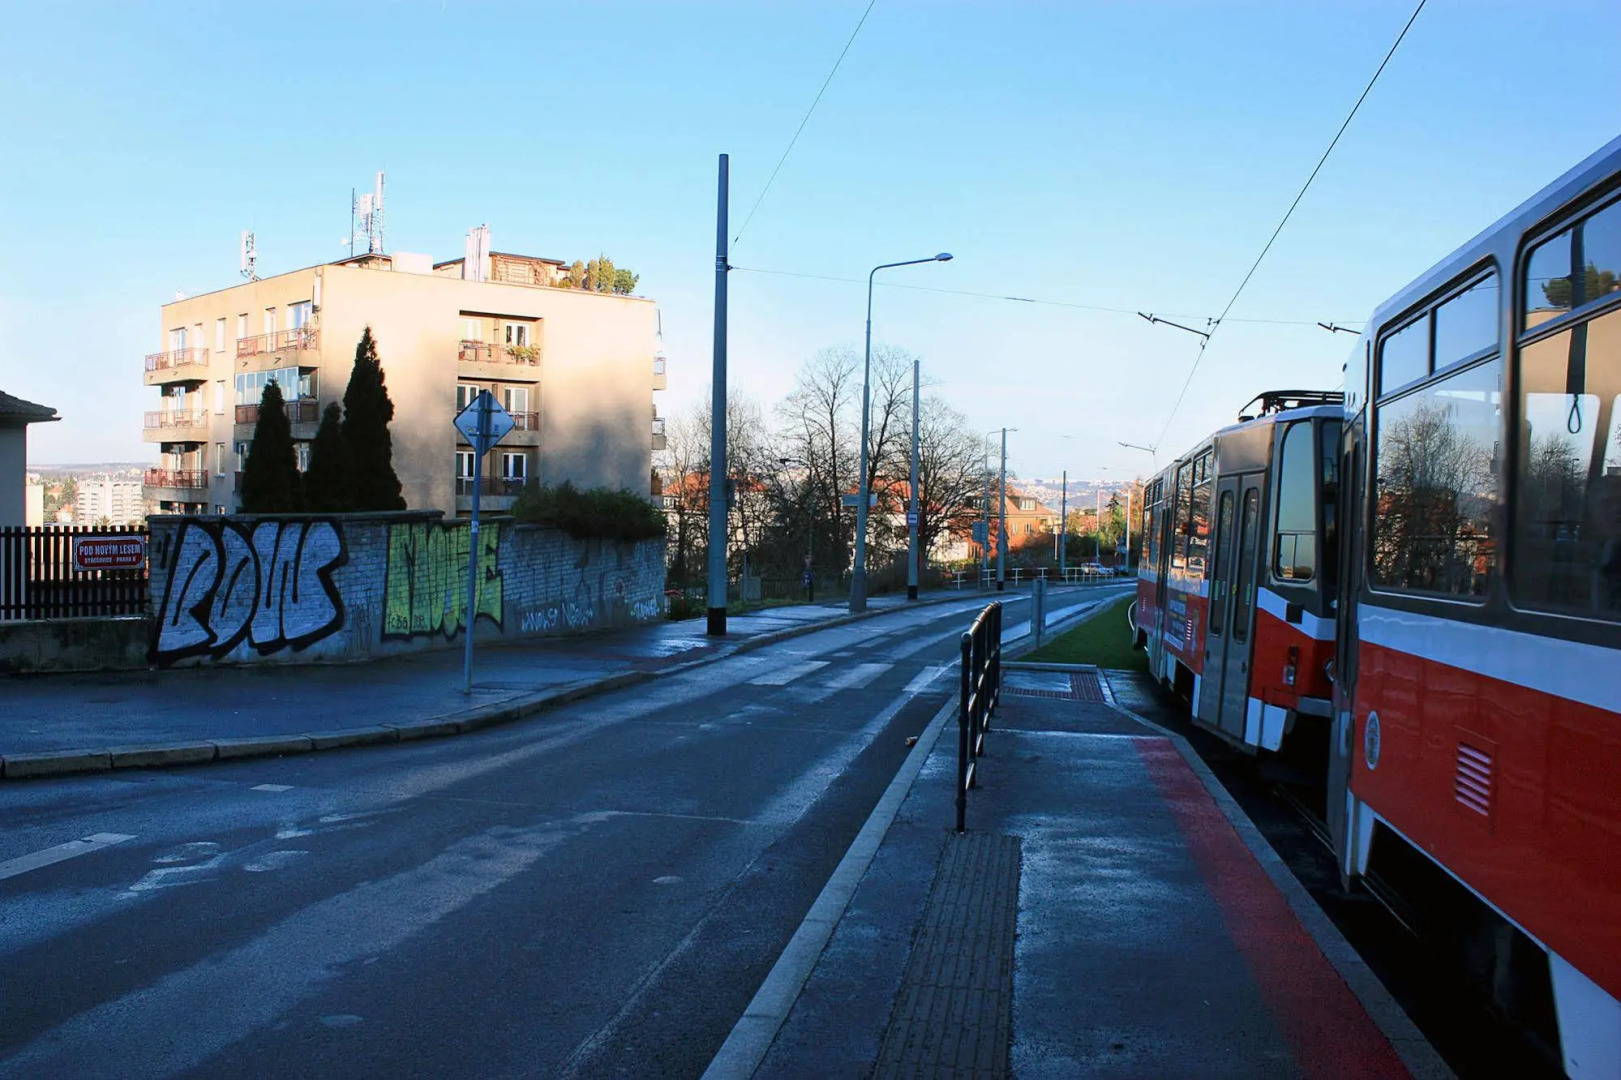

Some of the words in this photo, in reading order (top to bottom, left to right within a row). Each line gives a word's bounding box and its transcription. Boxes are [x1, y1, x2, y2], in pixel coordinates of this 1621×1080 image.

[80, 545, 93, 556] POD
[95, 544, 118, 555] NOVÝM
[120, 544, 140, 554] LESEM
